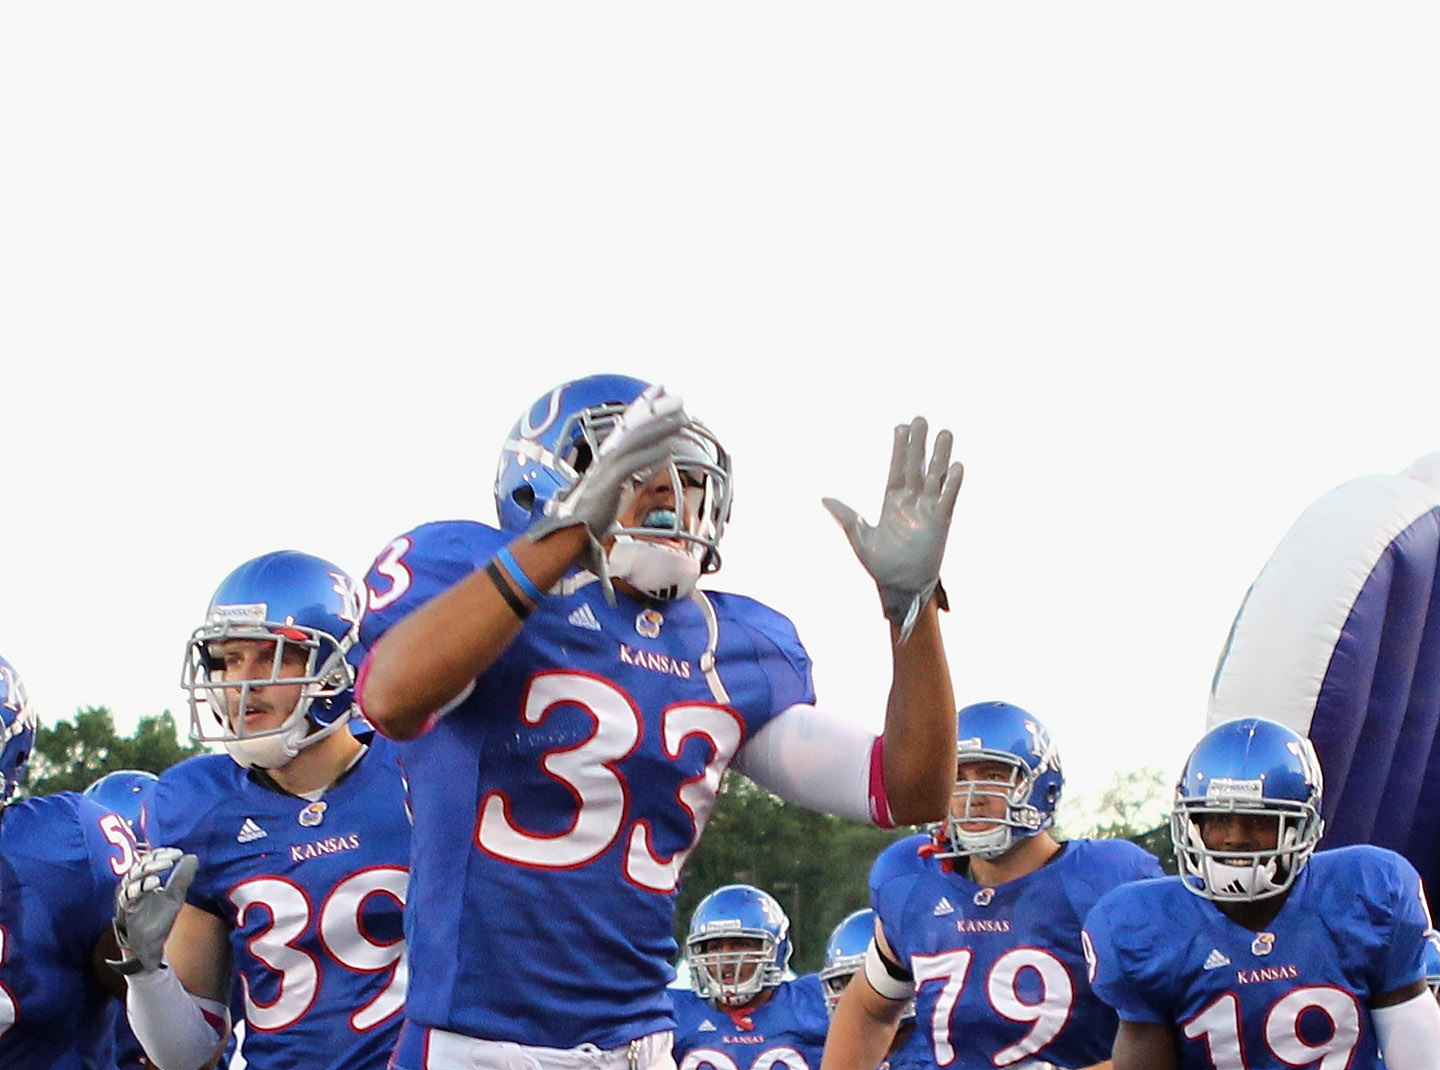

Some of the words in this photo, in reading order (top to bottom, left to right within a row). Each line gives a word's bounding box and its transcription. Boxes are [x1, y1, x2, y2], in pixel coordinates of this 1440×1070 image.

[619, 642, 691, 679] KANSAS
[474, 669, 747, 893] 33
[290, 833, 360, 862] KANSAS
[956, 920, 1011, 933] KANSAS
[227, 865, 410, 1033] 39
[1237, 965, 1299, 985] KANSAS
[911, 945, 1077, 1068] 79
[722, 1034, 765, 1044] KANSAS
